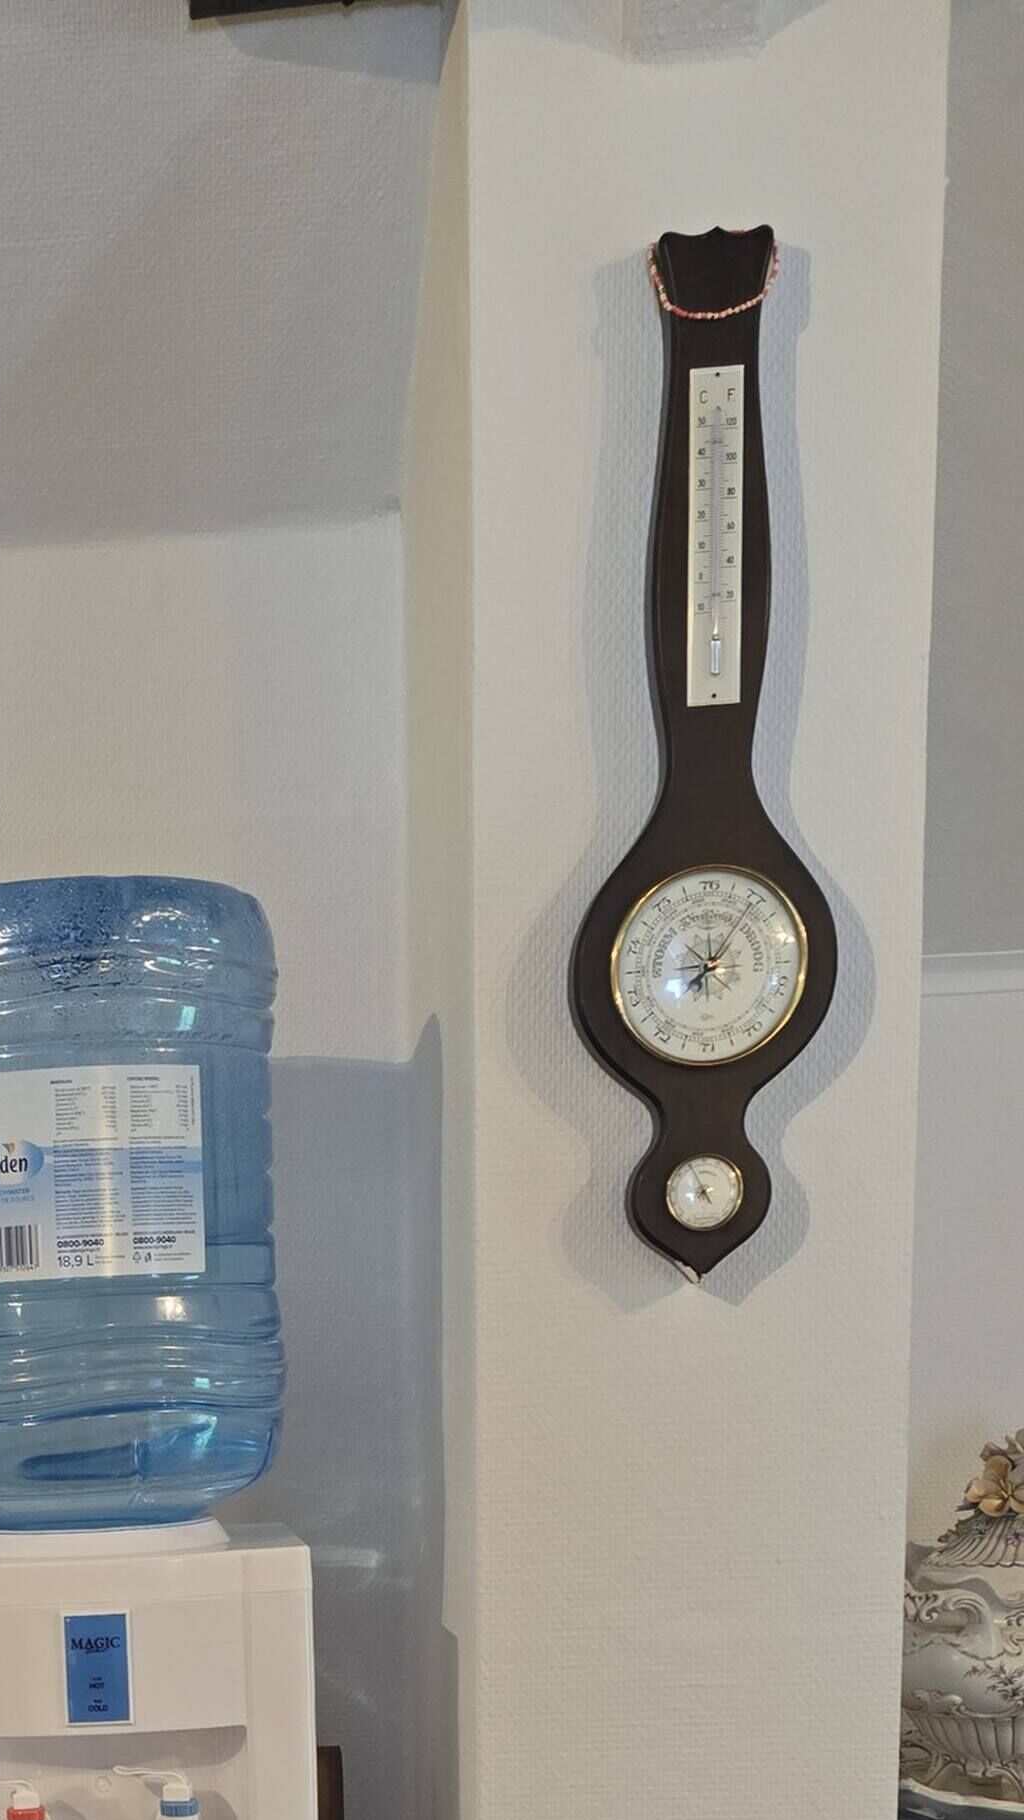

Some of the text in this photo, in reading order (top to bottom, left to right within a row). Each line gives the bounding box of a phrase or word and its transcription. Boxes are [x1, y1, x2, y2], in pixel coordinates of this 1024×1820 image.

[699, 387, 736, 404] C F
[697, 416, 737, 426] 50 120
[697, 447, 706, 456] 40
[725, 451, 737, 461] 100
[697, 478, 706, 488] 30
[727, 486, 736, 496] 80
[698, 541, 706, 550] 10
[726, 555, 735, 564] 40
[726, 590, 735, 599] 20
[699, 880, 721, 891] 76
[747, 887, 767, 906] 77
[652, 896, 672, 913] 75
[739, 922, 765, 974] DROOG
[742, 1020, 763, 1038] 70
[699, 1041, 716, 1053] 71
[57, 1238, 105, 1249] 0800-9040
[132, 1235, 177, 1245] 0800-9040
[57, 1254, 83, 1268] 18,9
[87, 1254, 95, 1266] L
[70, 1636, 121, 1650] MAGIC
[88, 1682, 105, 1690] HOT
[87, 1704, 109, 1713] COLD
